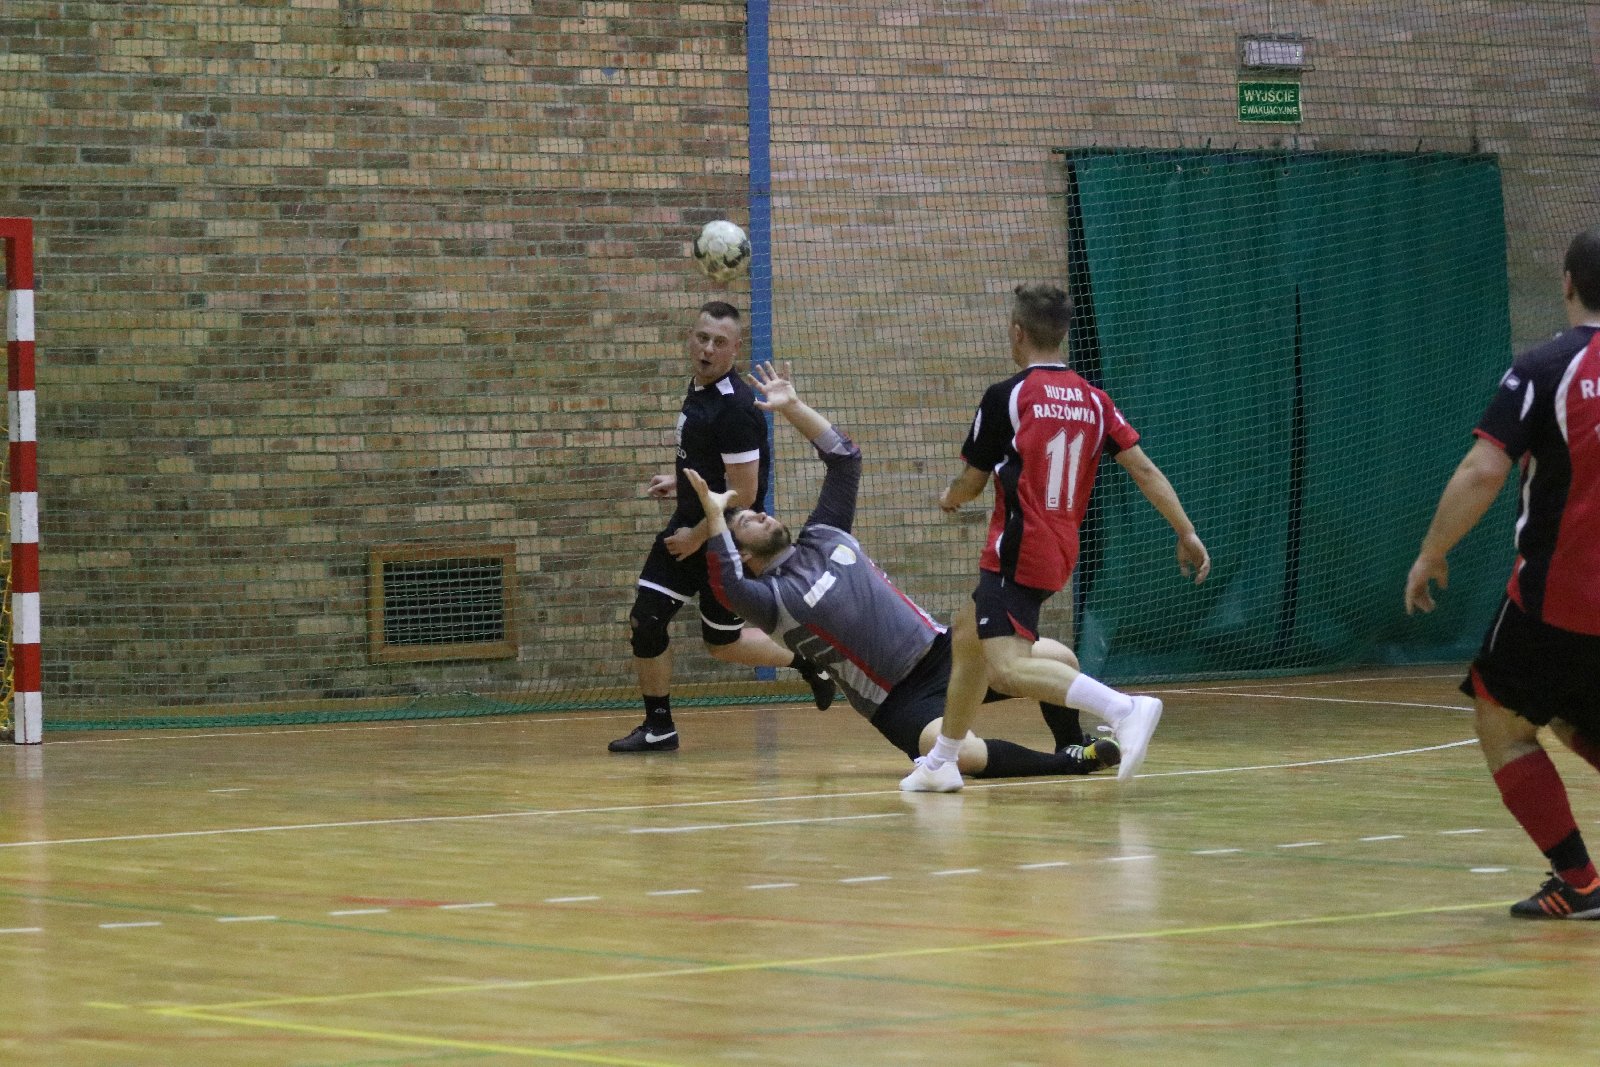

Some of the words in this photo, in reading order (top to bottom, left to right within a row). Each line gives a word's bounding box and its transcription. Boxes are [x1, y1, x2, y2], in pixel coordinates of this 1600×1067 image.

[1243, 88, 1295, 102] WYJŚCIE
[1241, 105, 1298, 115] EWAKUACYJNE
[1044, 384, 1084, 402] HUZAR
[1033, 404, 1096, 424] RASZÓWKA
[1046, 427, 1085, 511] 11
